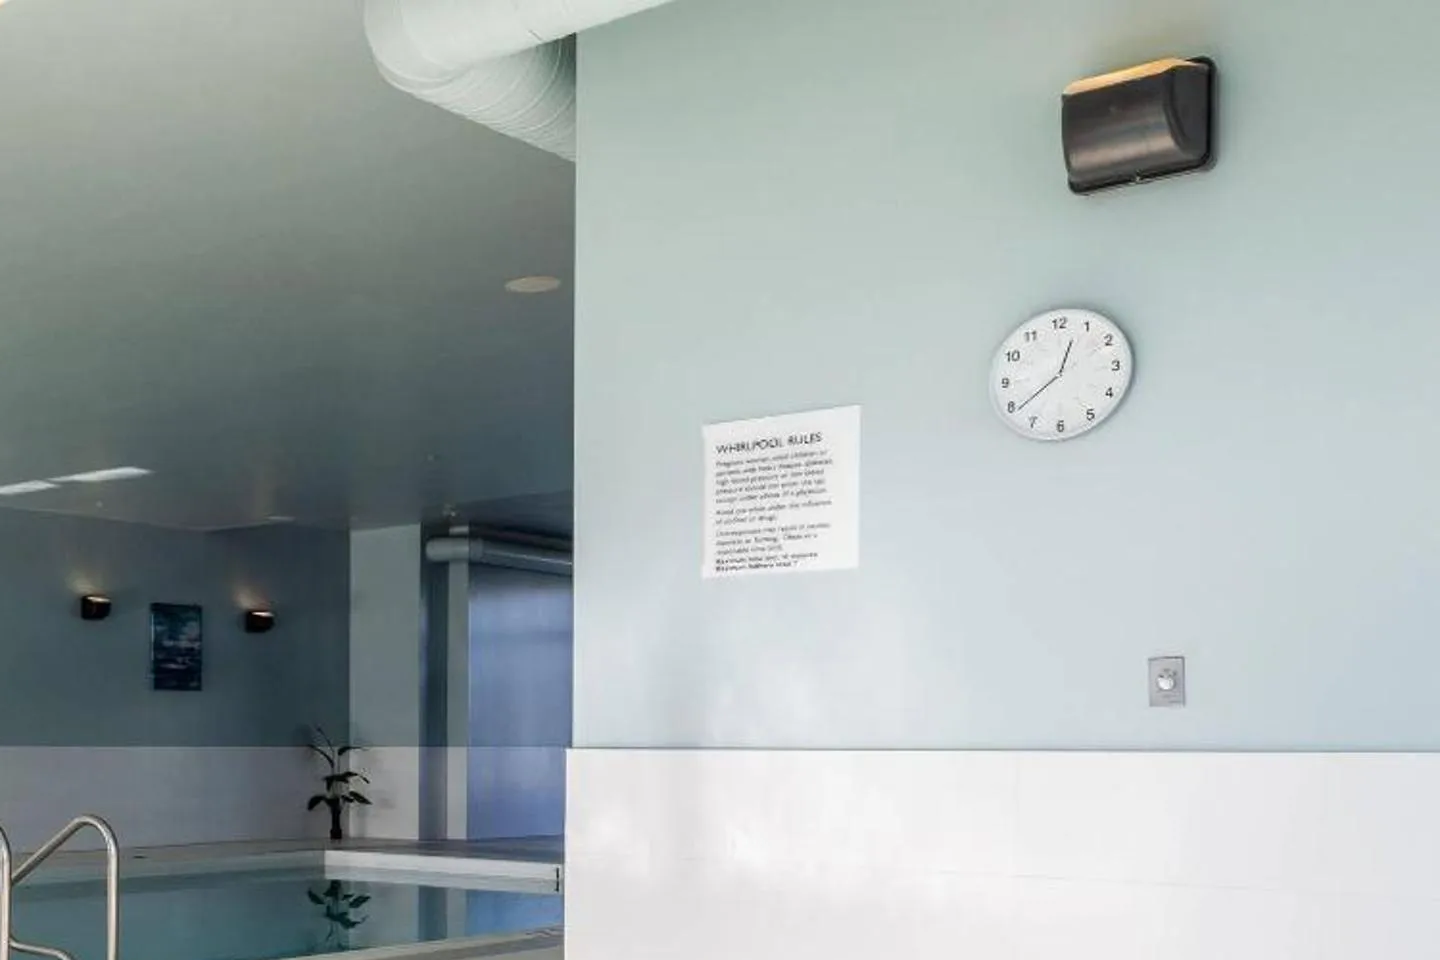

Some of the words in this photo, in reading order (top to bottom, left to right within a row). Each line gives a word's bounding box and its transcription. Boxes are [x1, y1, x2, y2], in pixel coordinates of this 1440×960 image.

[1052, 317, 1068, 329] 12
[1084, 321, 1090, 332] 1
[1024, 331, 1037, 342] 11
[1104, 334, 1113, 346] 2
[1006, 350, 1020, 362] 10
[1112, 360, 1120, 371] 3
[1001, 378, 1009, 388] 9
[1105, 387, 1113, 398] 4
[1086, 408, 1095, 421] 5
[1029, 416, 1038, 428] 7
[1057, 420, 1064, 432] 6
[716, 437, 783, 454] WHIRLPOOL
[787, 432, 823, 446] RULES
